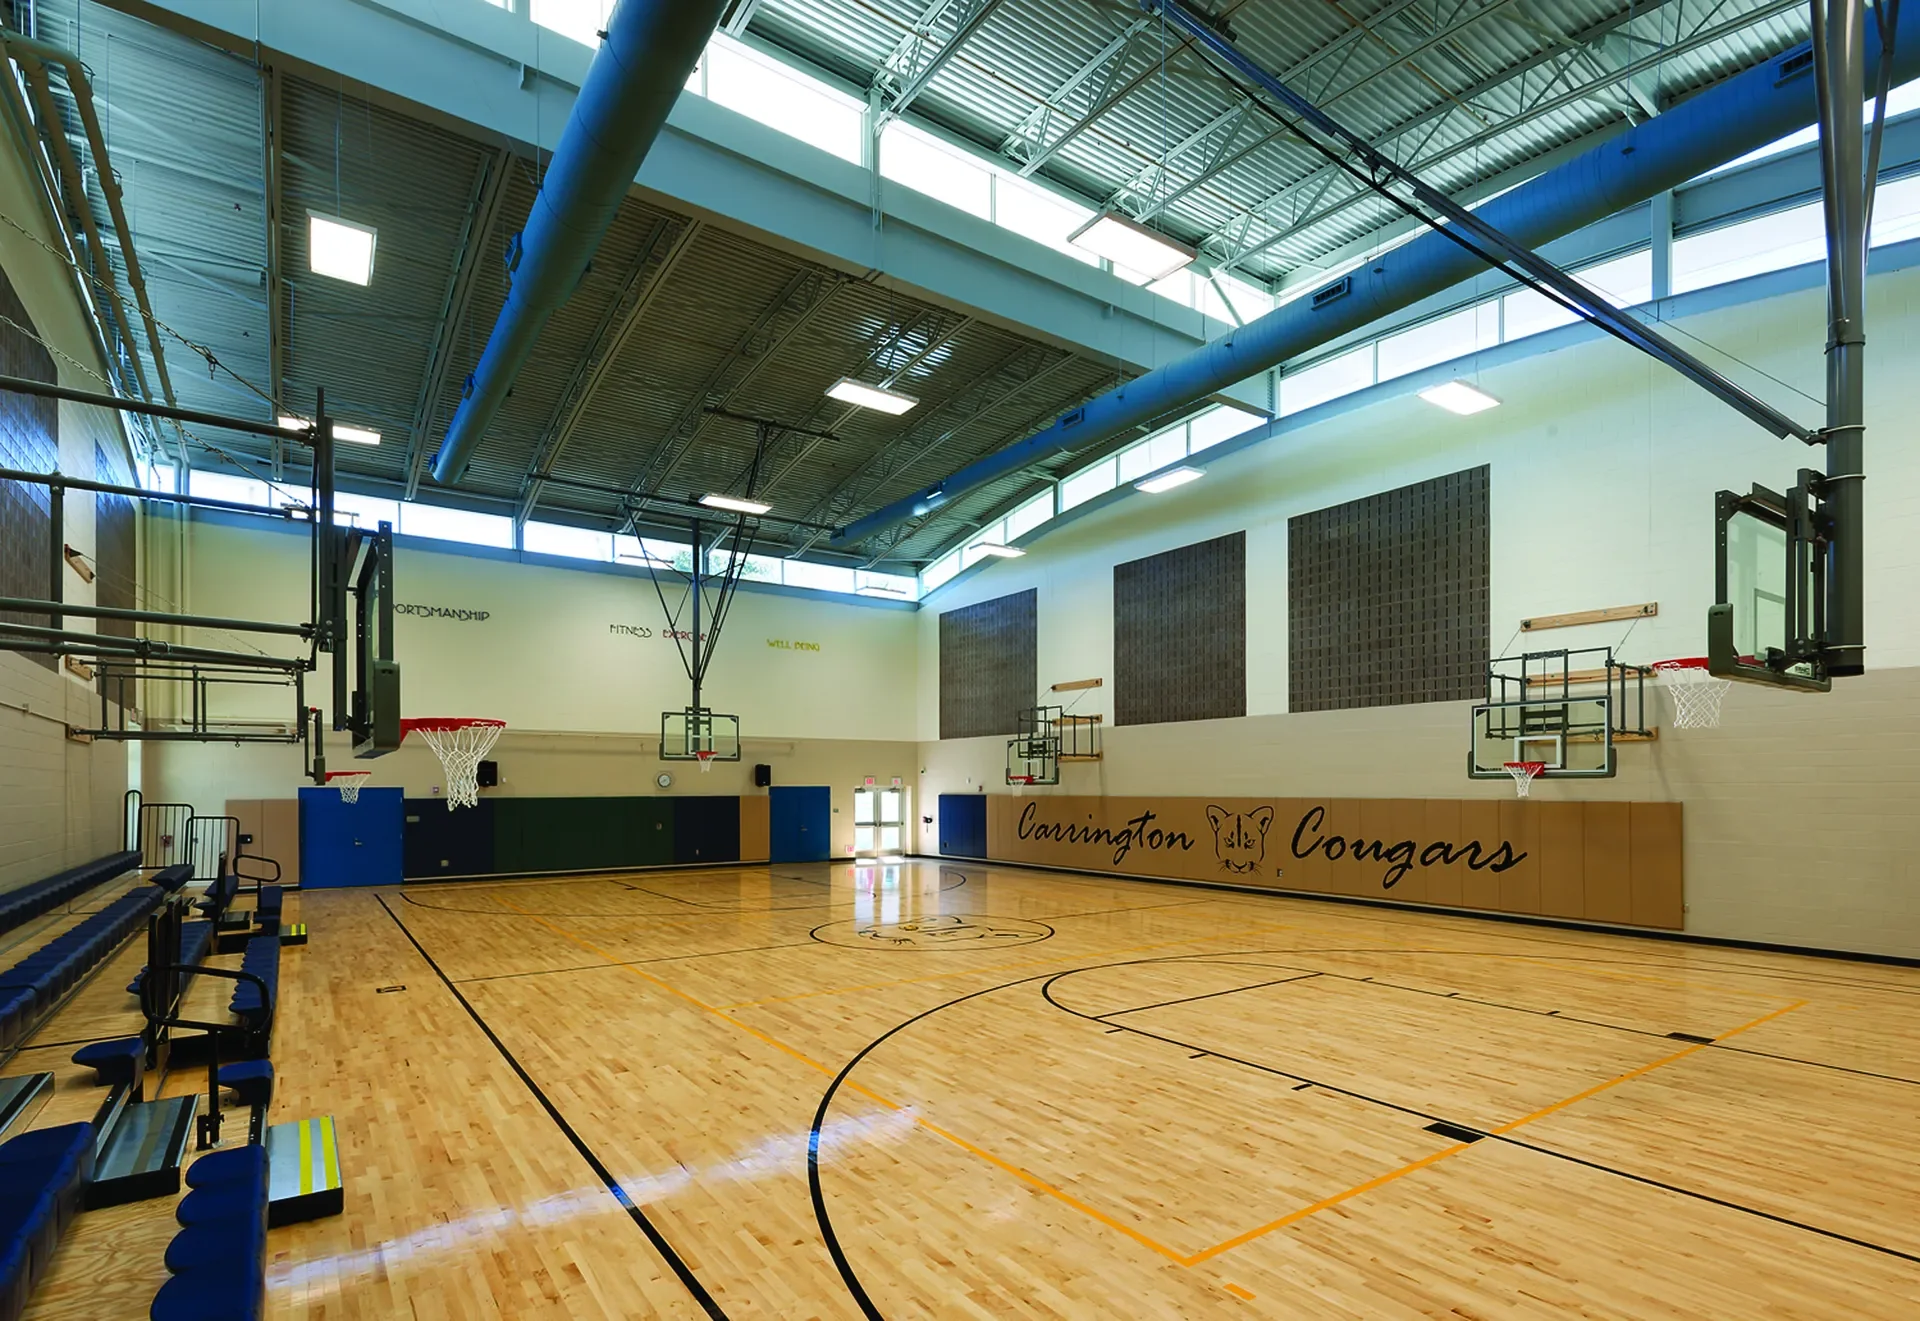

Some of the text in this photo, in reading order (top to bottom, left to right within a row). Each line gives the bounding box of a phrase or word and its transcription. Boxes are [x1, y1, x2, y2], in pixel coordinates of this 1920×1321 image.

[393, 603, 490, 621] ORTSMANSHIP
[609, 624, 652, 638] FITNESS
[662, 629, 707, 642] EXERCE
[766, 638, 792, 650] WELL
[1018, 802, 1528, 889] Carrington Cougars
